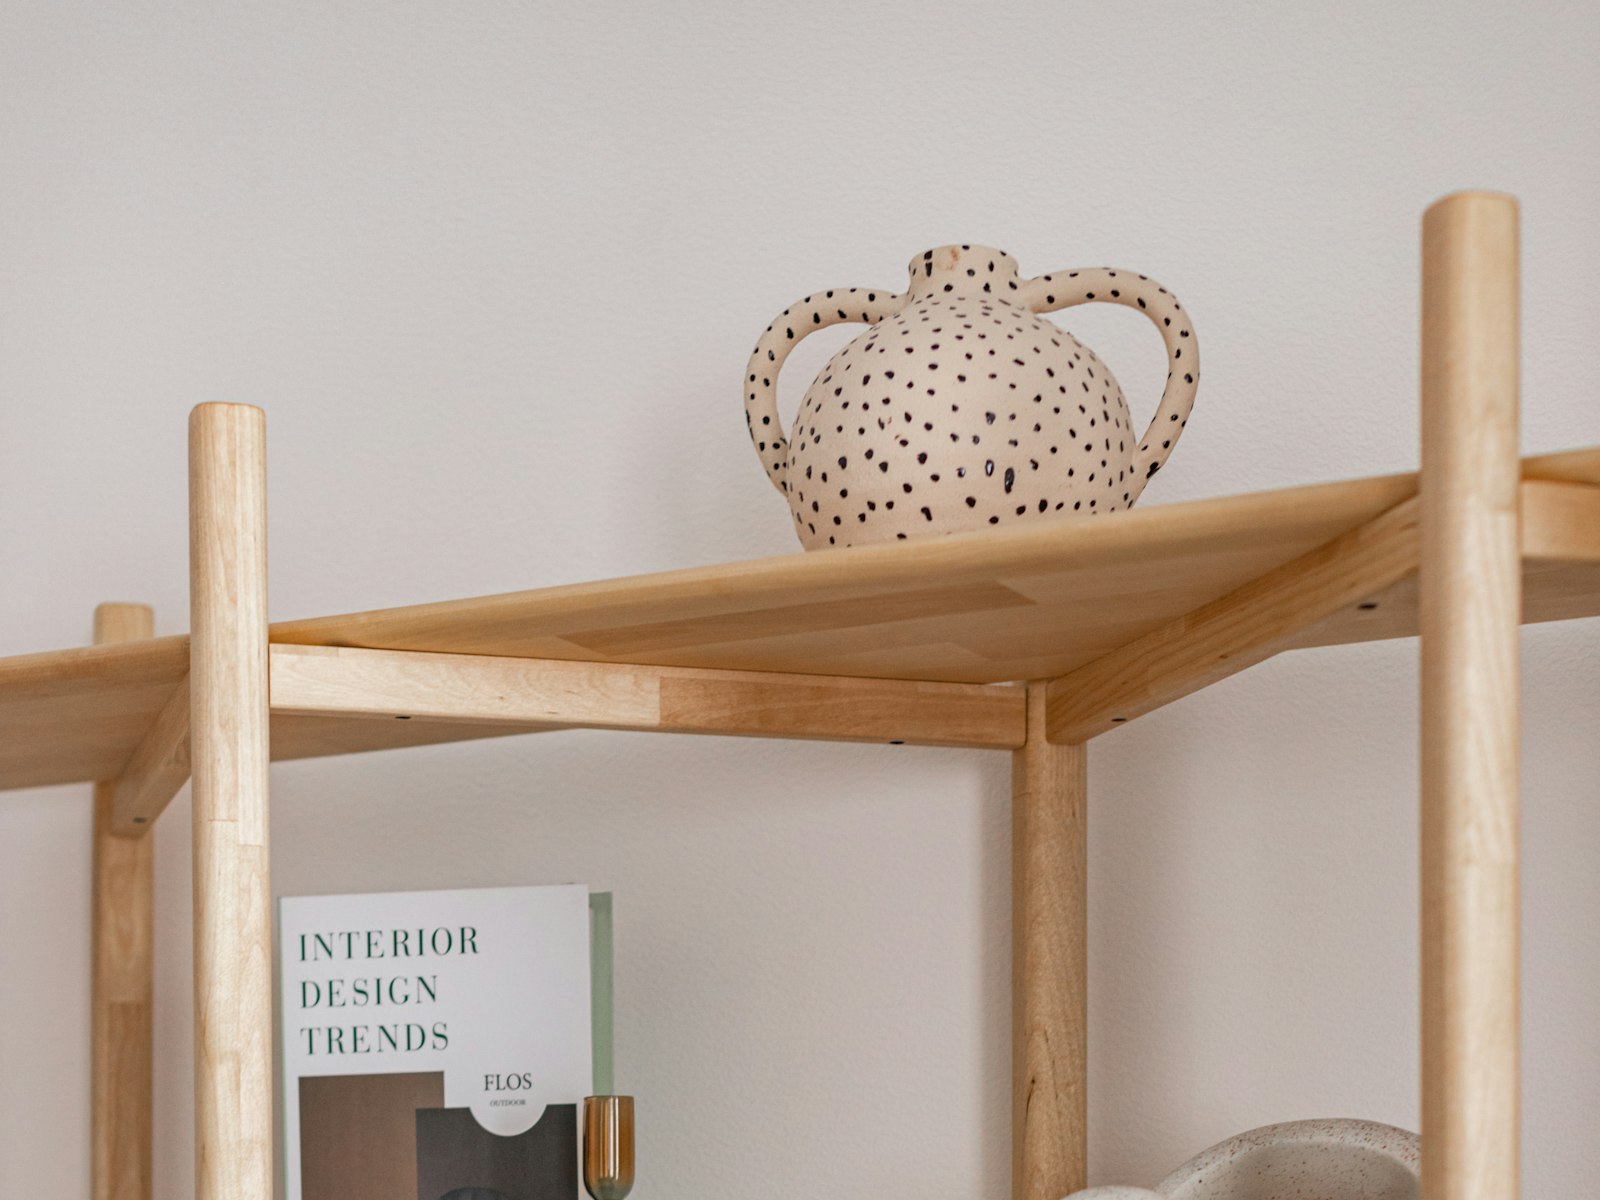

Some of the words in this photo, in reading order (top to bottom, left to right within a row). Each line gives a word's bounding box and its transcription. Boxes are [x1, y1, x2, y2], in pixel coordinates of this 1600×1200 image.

[299, 926, 480, 962] INTERIOR
[299, 975, 439, 1009] DESIGN
[300, 1021, 450, 1056] TRENDS
[484, 1073, 532, 1091] FLOS
[490, 1099, 526, 1107] OUTDOOR
